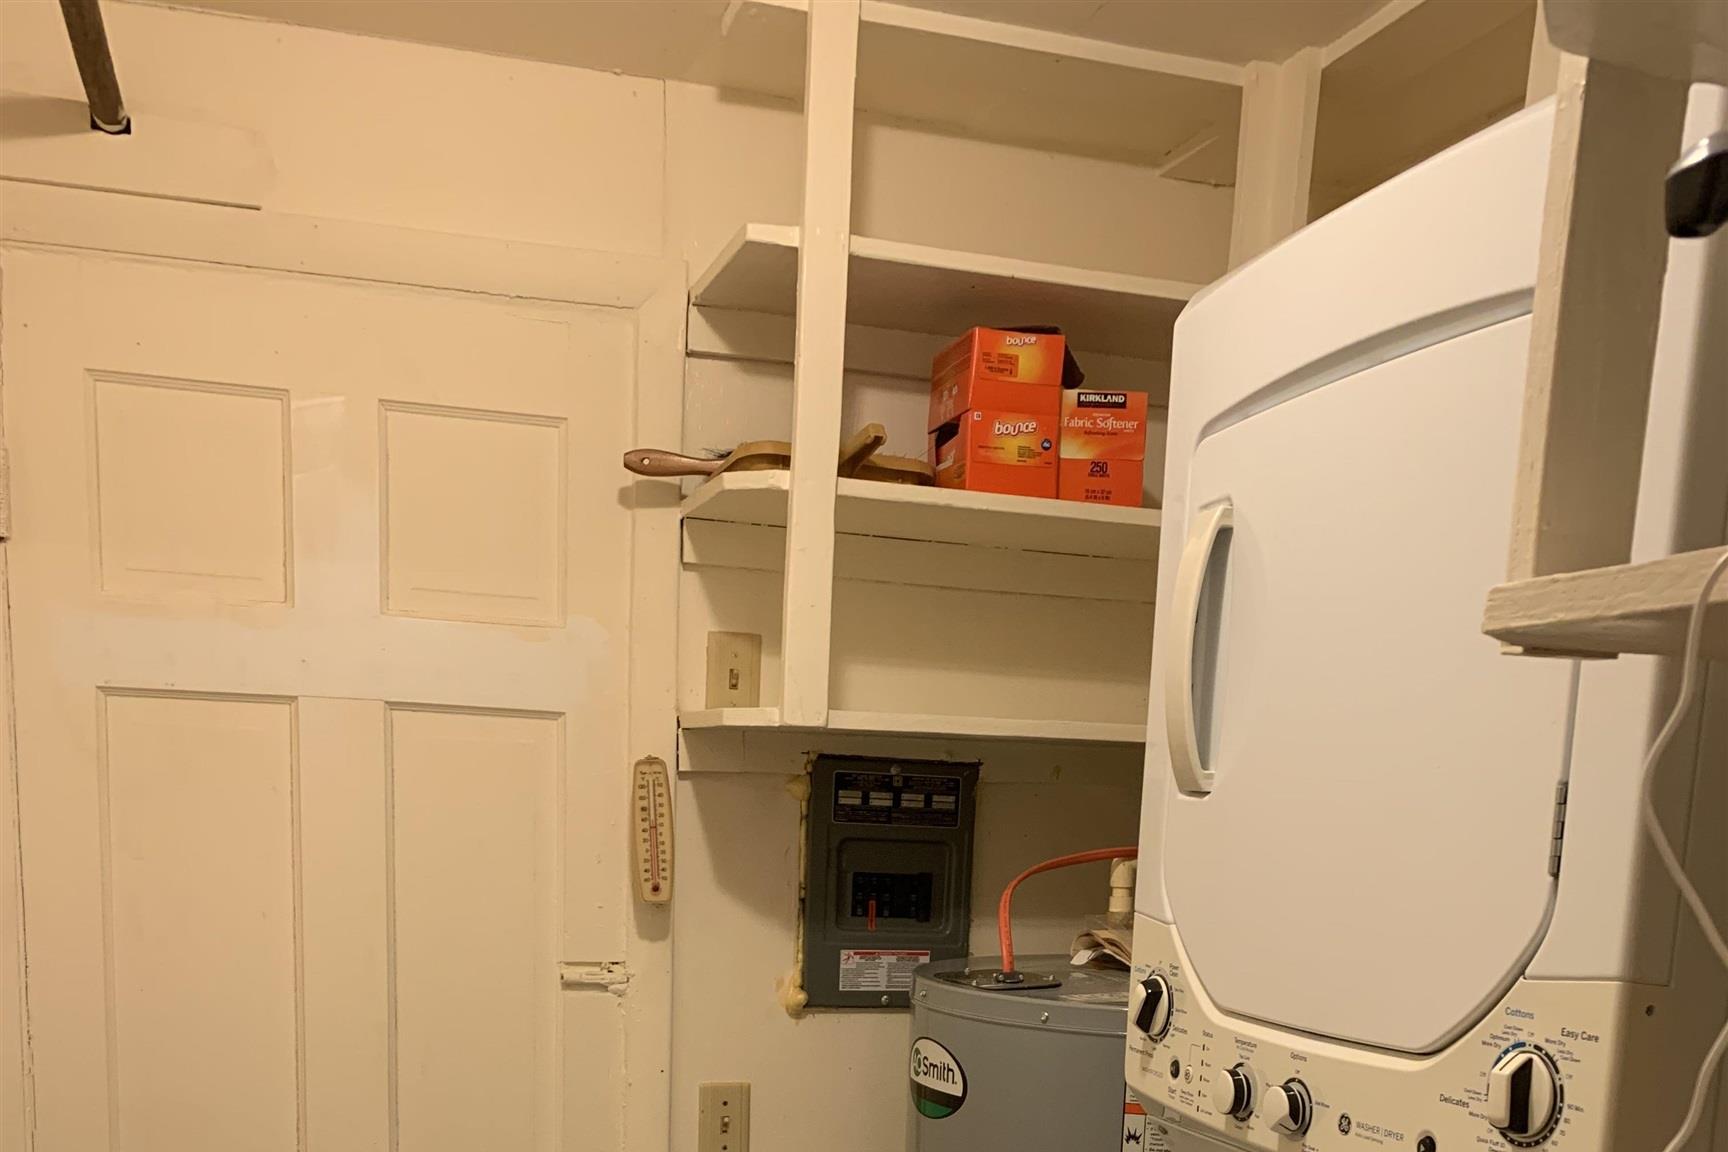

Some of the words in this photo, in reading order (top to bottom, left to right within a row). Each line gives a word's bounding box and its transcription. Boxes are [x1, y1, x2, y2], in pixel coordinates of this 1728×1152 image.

[1005, 335, 1037, 346] bounce
[1079, 393, 1125, 404] KIRKLAND
[994, 421, 1037, 436] bounce
[1064, 416, 1094, 428] Fabric
[1096, 417, 1139, 431] Softener
[1090, 461, 1109, 475] 250
[1505, 1006, 1535, 1020] Cottons
[1561, 1027, 1580, 1041] Easy
[1581, 1031, 1600, 1043] Care
[1289, 1051, 1308, 1063] Options
[1439, 1093, 1470, 1109] Delicates
[1356, 1121, 1380, 1135] WASHER
[1384, 1128, 1405, 1142] DRYER
